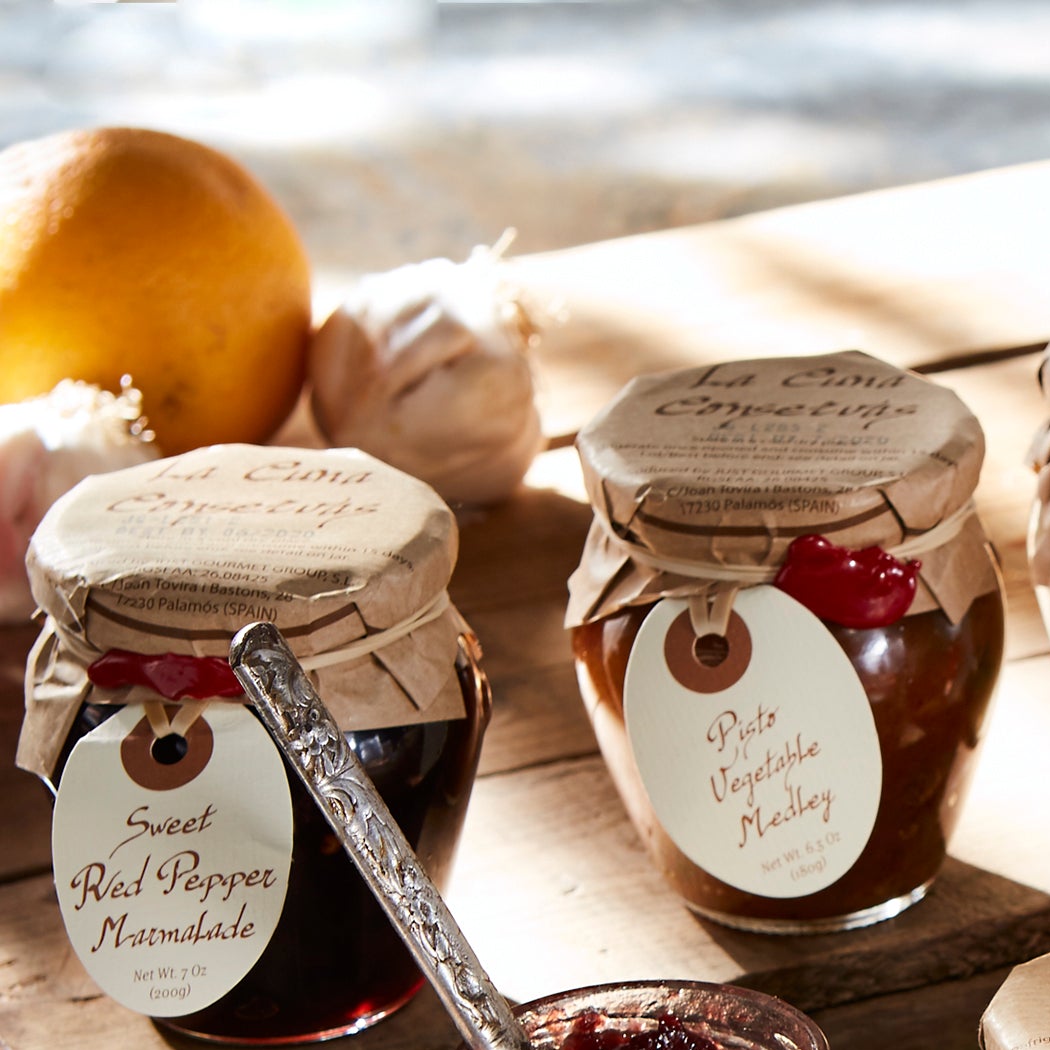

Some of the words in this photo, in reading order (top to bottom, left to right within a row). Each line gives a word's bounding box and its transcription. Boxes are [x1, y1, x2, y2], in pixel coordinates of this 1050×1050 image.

[688, 363, 757, 390] La
[781, 366, 906, 390] Cuna
[787, 500, 841, 516] (SPAIN)
[199, 567, 270, 585] 26.08425
[271, 566, 329, 583] GROUP,
[154, 578, 198, 594] Tovira
[208, 582, 271, 601] Bastons,
[157, 595, 220, 615] Palamós
[222, 601, 279, 623] (SPAIN)
[706, 701, 781, 760] Pisto
[708, 732, 823, 808] Vegetable
[738, 783, 837, 849] Medley
[109, 803, 218, 860] Sweet
[760, 856, 782, 874] Net
[70, 853, 152, 912] Red
[156, 850, 278, 904] Pepper
[90, 901, 257, 953] Marmalade
[133, 967, 155, 983] Net
[157, 966, 178, 982] Wt.
[181, 967, 189, 981] 7
[190, 963, 208, 978] Oz
[148, 982, 192, 1001] (200g)
